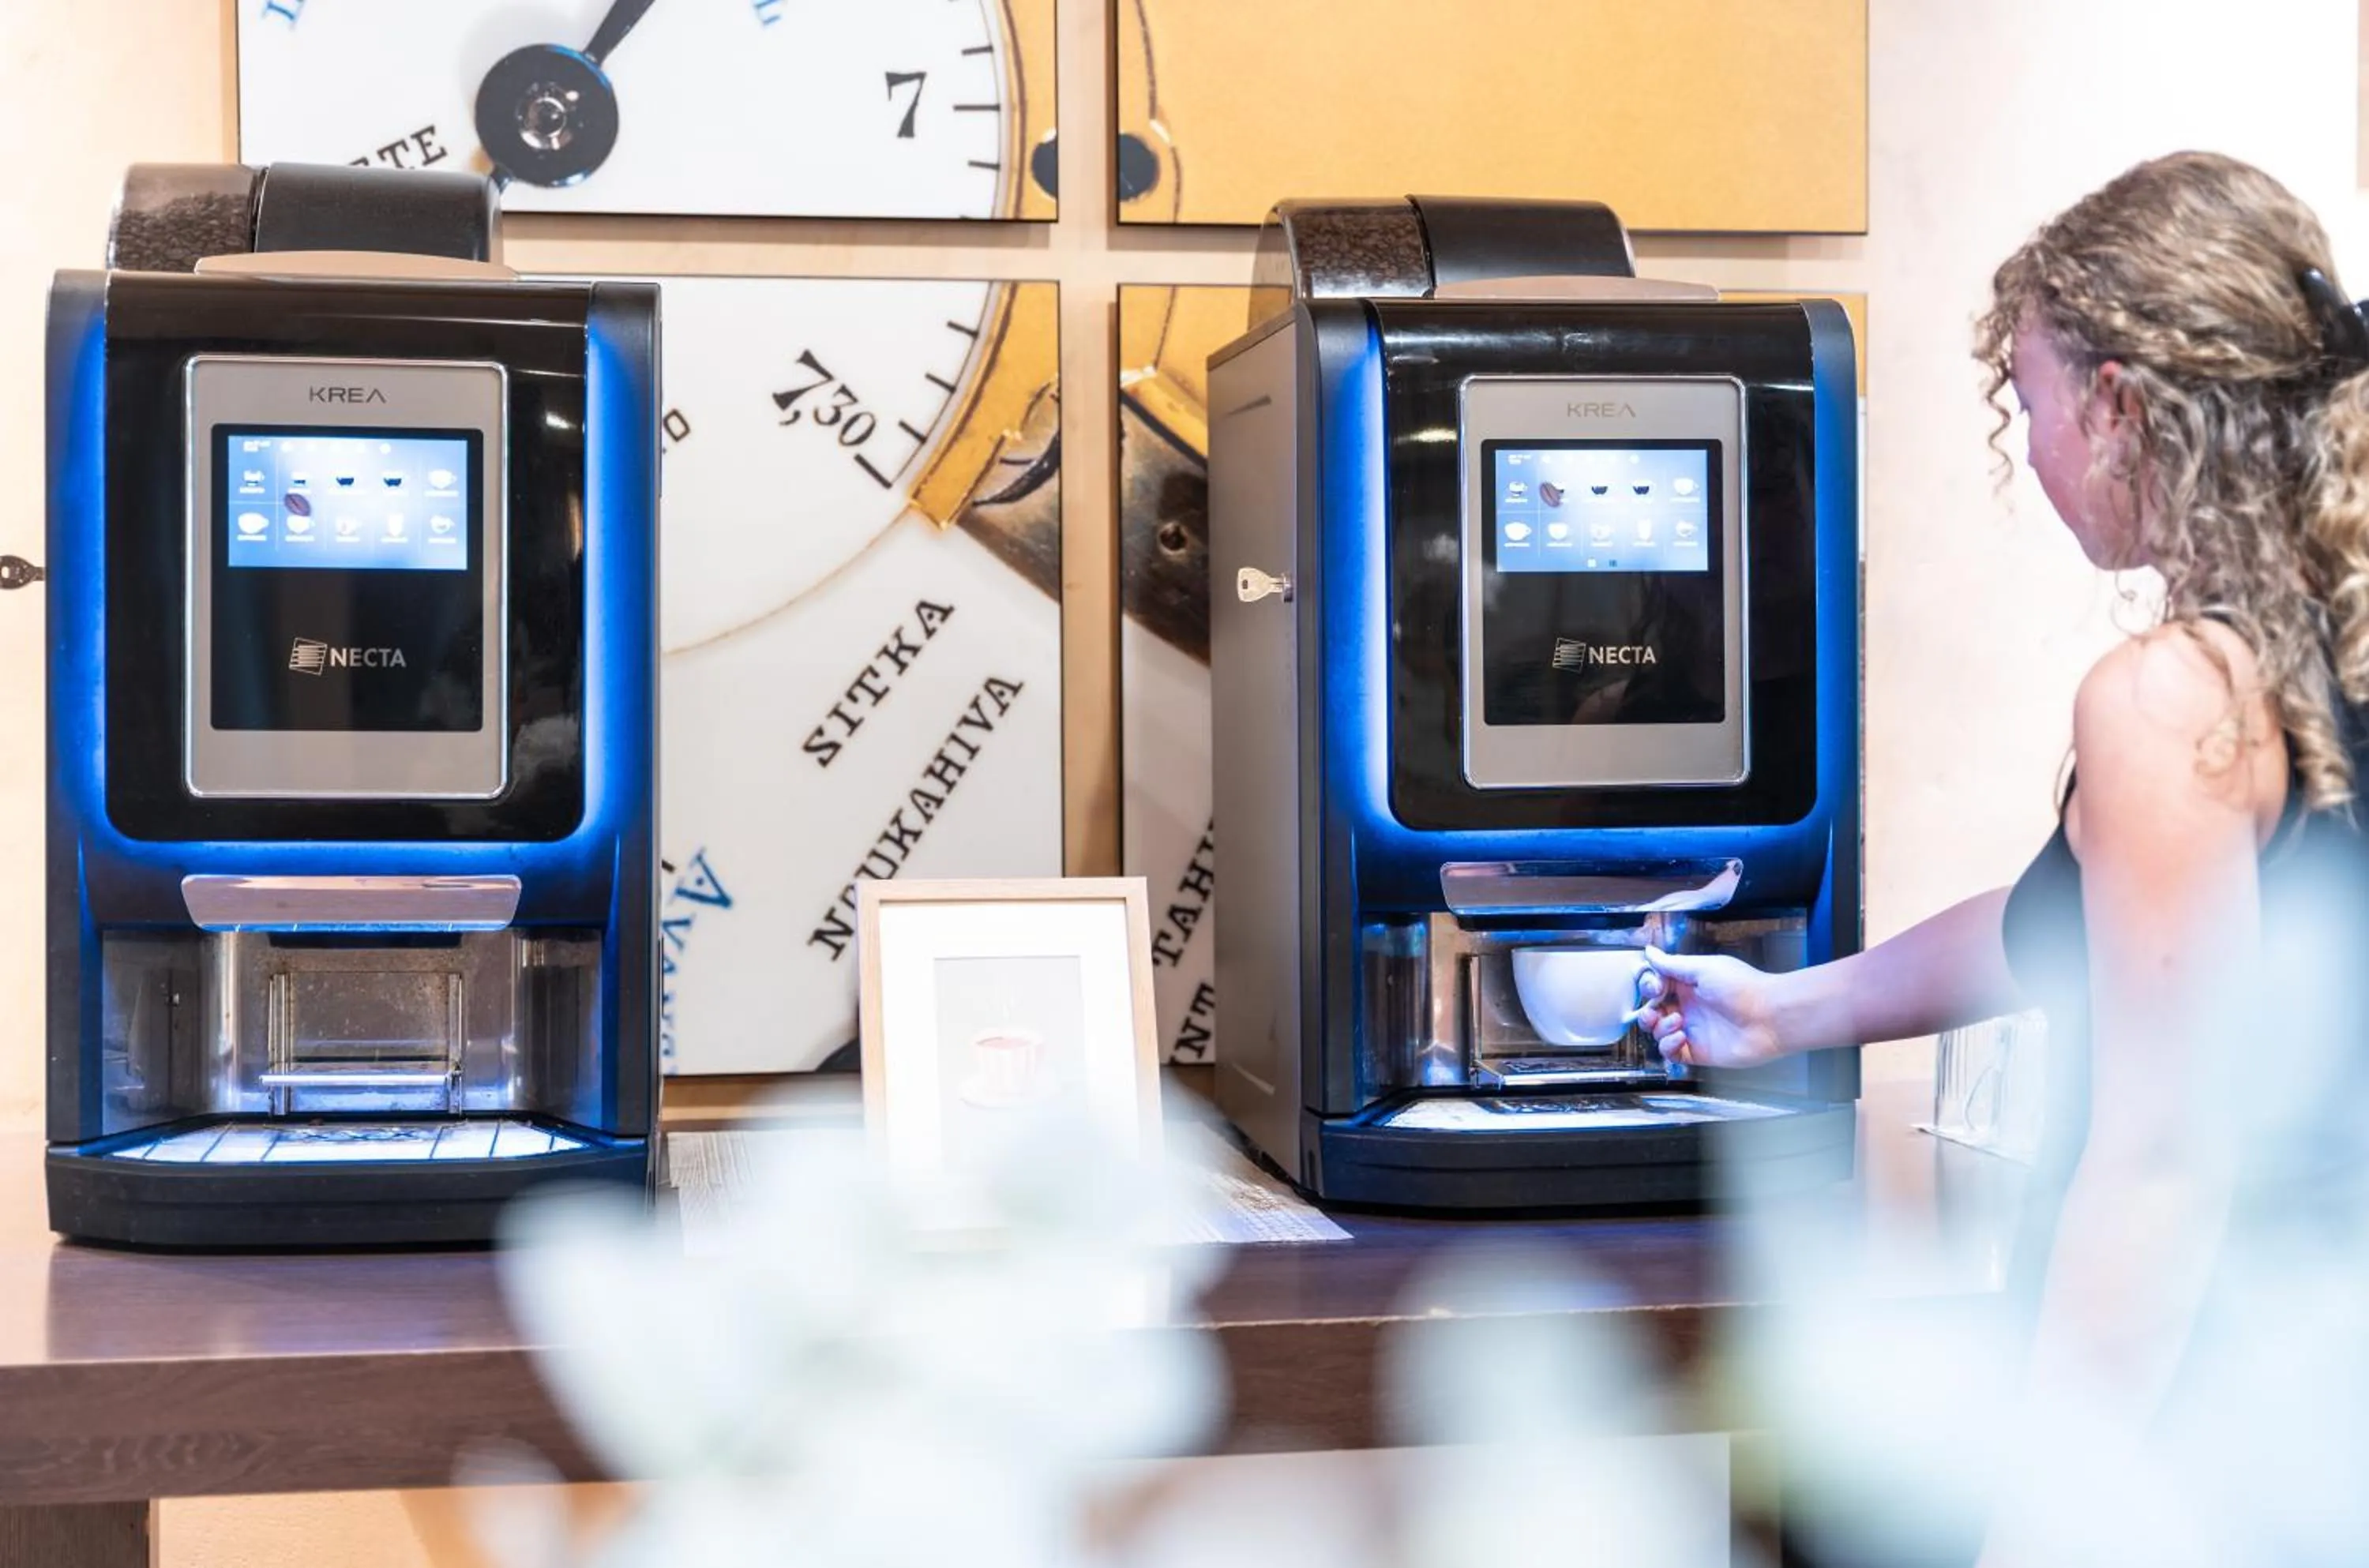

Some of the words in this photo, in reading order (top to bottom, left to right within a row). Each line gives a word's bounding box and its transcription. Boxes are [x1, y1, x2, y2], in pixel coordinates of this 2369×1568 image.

[884, 71, 927, 138] 7
[349, 124, 448, 169] TE
[310, 386, 386, 403] KREA
[1567, 403, 1636, 419] KREA
[330, 647, 407, 668] NECTA
[1588, 646, 1657, 665] NECTA
[802, 600, 955, 767] SITKA
